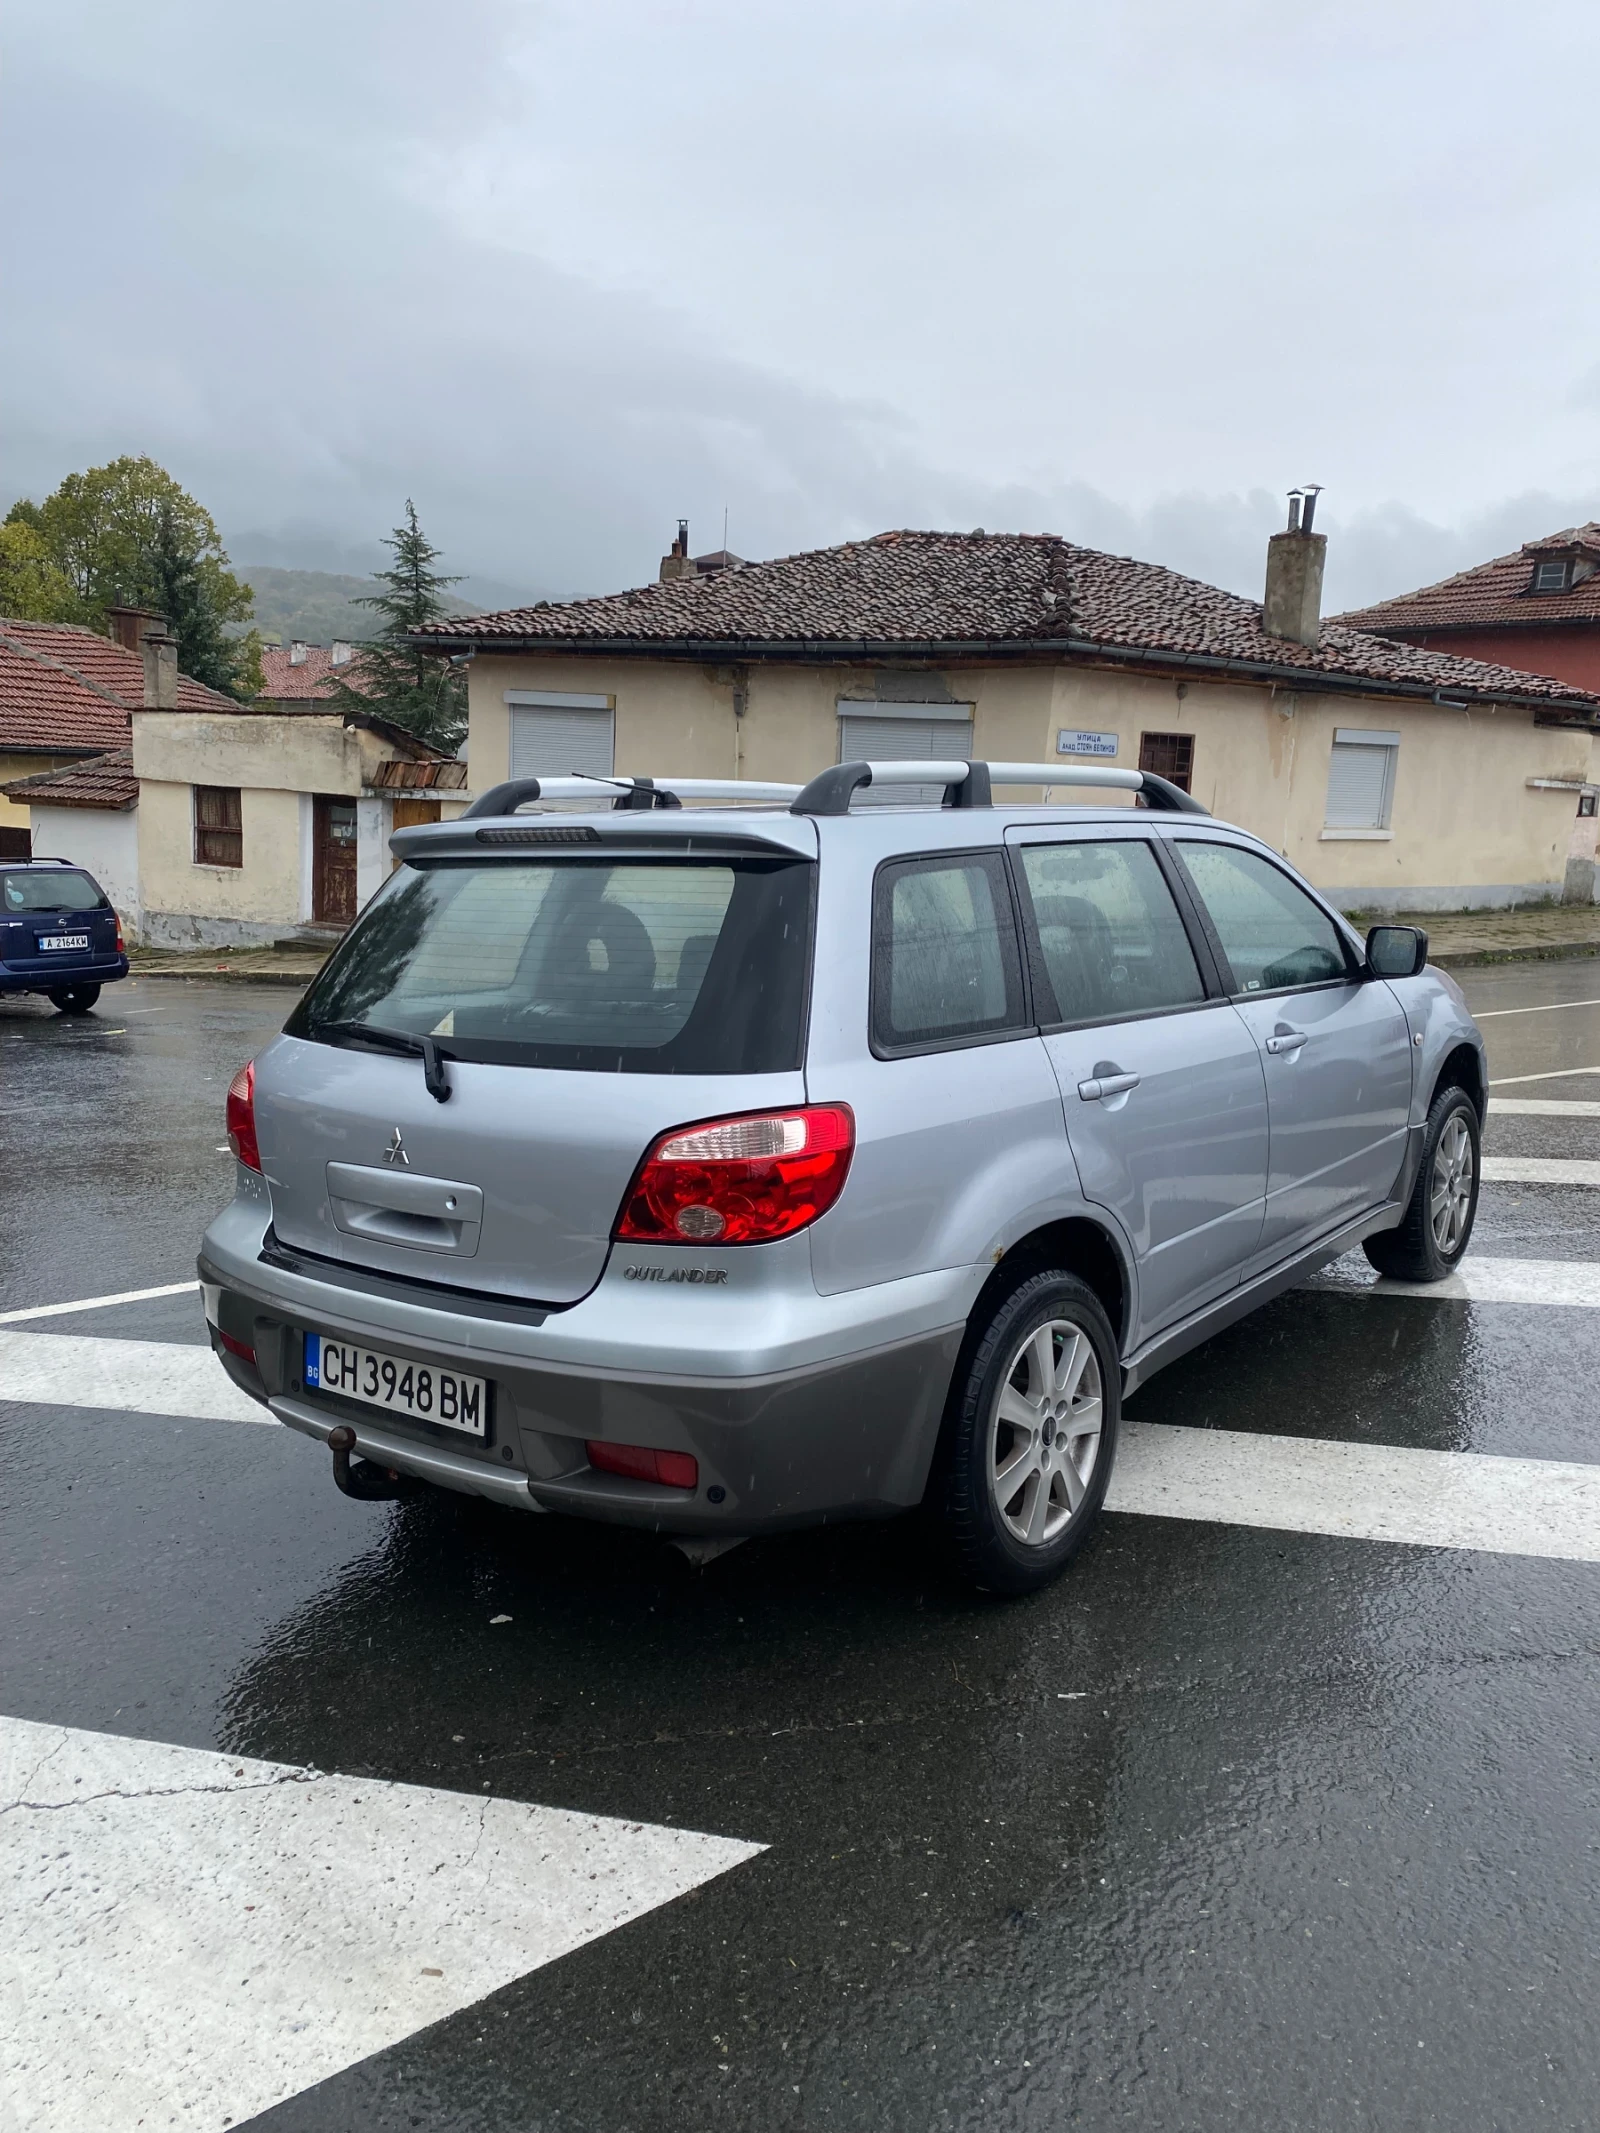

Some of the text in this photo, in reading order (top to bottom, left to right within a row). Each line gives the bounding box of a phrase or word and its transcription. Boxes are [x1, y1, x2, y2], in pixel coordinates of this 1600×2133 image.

[1077, 733, 1101, 743] УЛИЦА
[623, 1264, 729, 1284] OUTLANDER
[307, 1365, 318, 1379] BG
